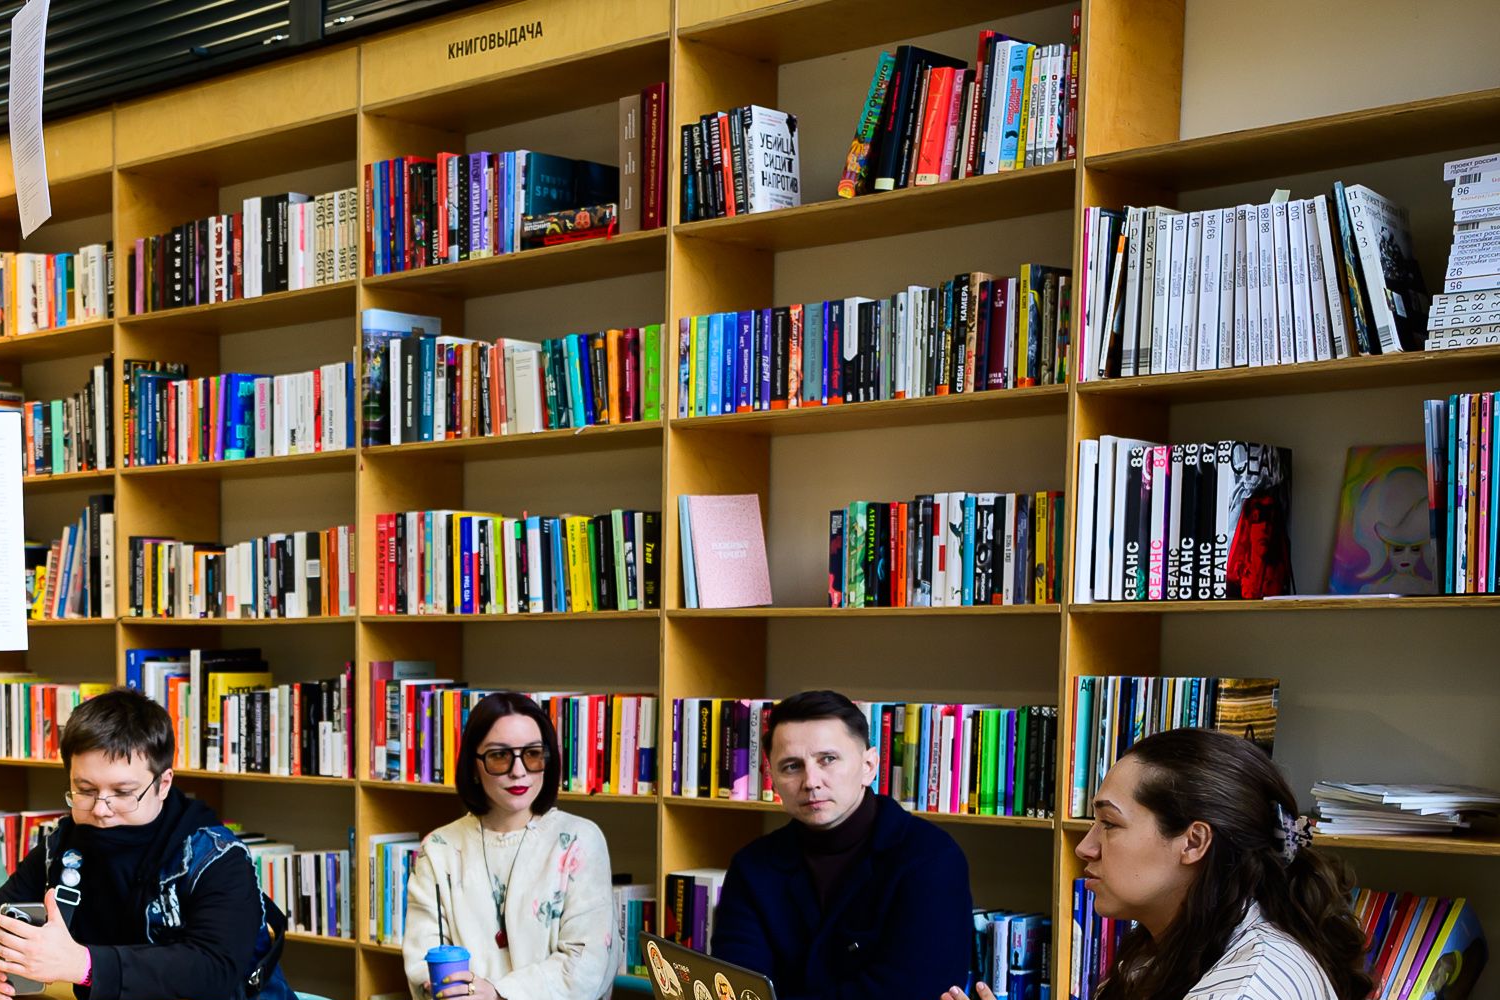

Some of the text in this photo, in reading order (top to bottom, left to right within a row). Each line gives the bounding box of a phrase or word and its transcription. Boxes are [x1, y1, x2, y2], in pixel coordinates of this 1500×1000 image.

[447, 20, 543, 59] КНИГОВЫДАЧА
[857, 63, 889, 143] Gastro Obscura
[759, 132, 796, 156] УБИЙЦА
[763, 152, 794, 173] СИДИТ
[1450, 157, 1498, 170] проект россия
[761, 170, 798, 193] НАПРОТИВ
[472, 182, 481, 215] ГРЕБЕР
[1306, 202, 1316, 214] 96
[1190, 217, 1200, 228] 91
[1225, 212, 1234, 224] 95
[1247, 210, 1256, 221] 97
[1260, 208, 1270, 233] 88/89
[1275, 205, 1285, 217] 92
[1290, 205, 1300, 221] 100
[338, 192, 347, 280] 1986 1988
[349, 190, 357, 278] 1995 1997
[1158, 219, 1167, 231] 87
[1174, 219, 1184, 231] 90
[1206, 214, 1216, 240] 93/94
[315, 197, 325, 284] 1992 1994
[325, 195, 335, 282] 1989 1991
[956, 285, 968, 393] СЕЛБИ КАМЕРА
[1130, 446, 1143, 468] 83
[1153, 446, 1166, 468] 84
[1171, 445, 1184, 463] 85
[1184, 443, 1199, 466] 86
[1202, 443, 1215, 463] 87
[1217, 441, 1231, 464] 88
[378, 530, 386, 594] СТРАТЕГИЯ
[1124, 541, 1139, 600] СЕАНС
[1148, 539, 1163, 600] СЕАНС
[1167, 547, 1180, 599] СЕАНС
[1179, 537, 1194, 600] СЕАНС
[1198, 542, 1212, 599] СЕАНС
[1214, 533, 1228, 598] СЕАНС
[701, 707, 709, 748] ФОНТАН
